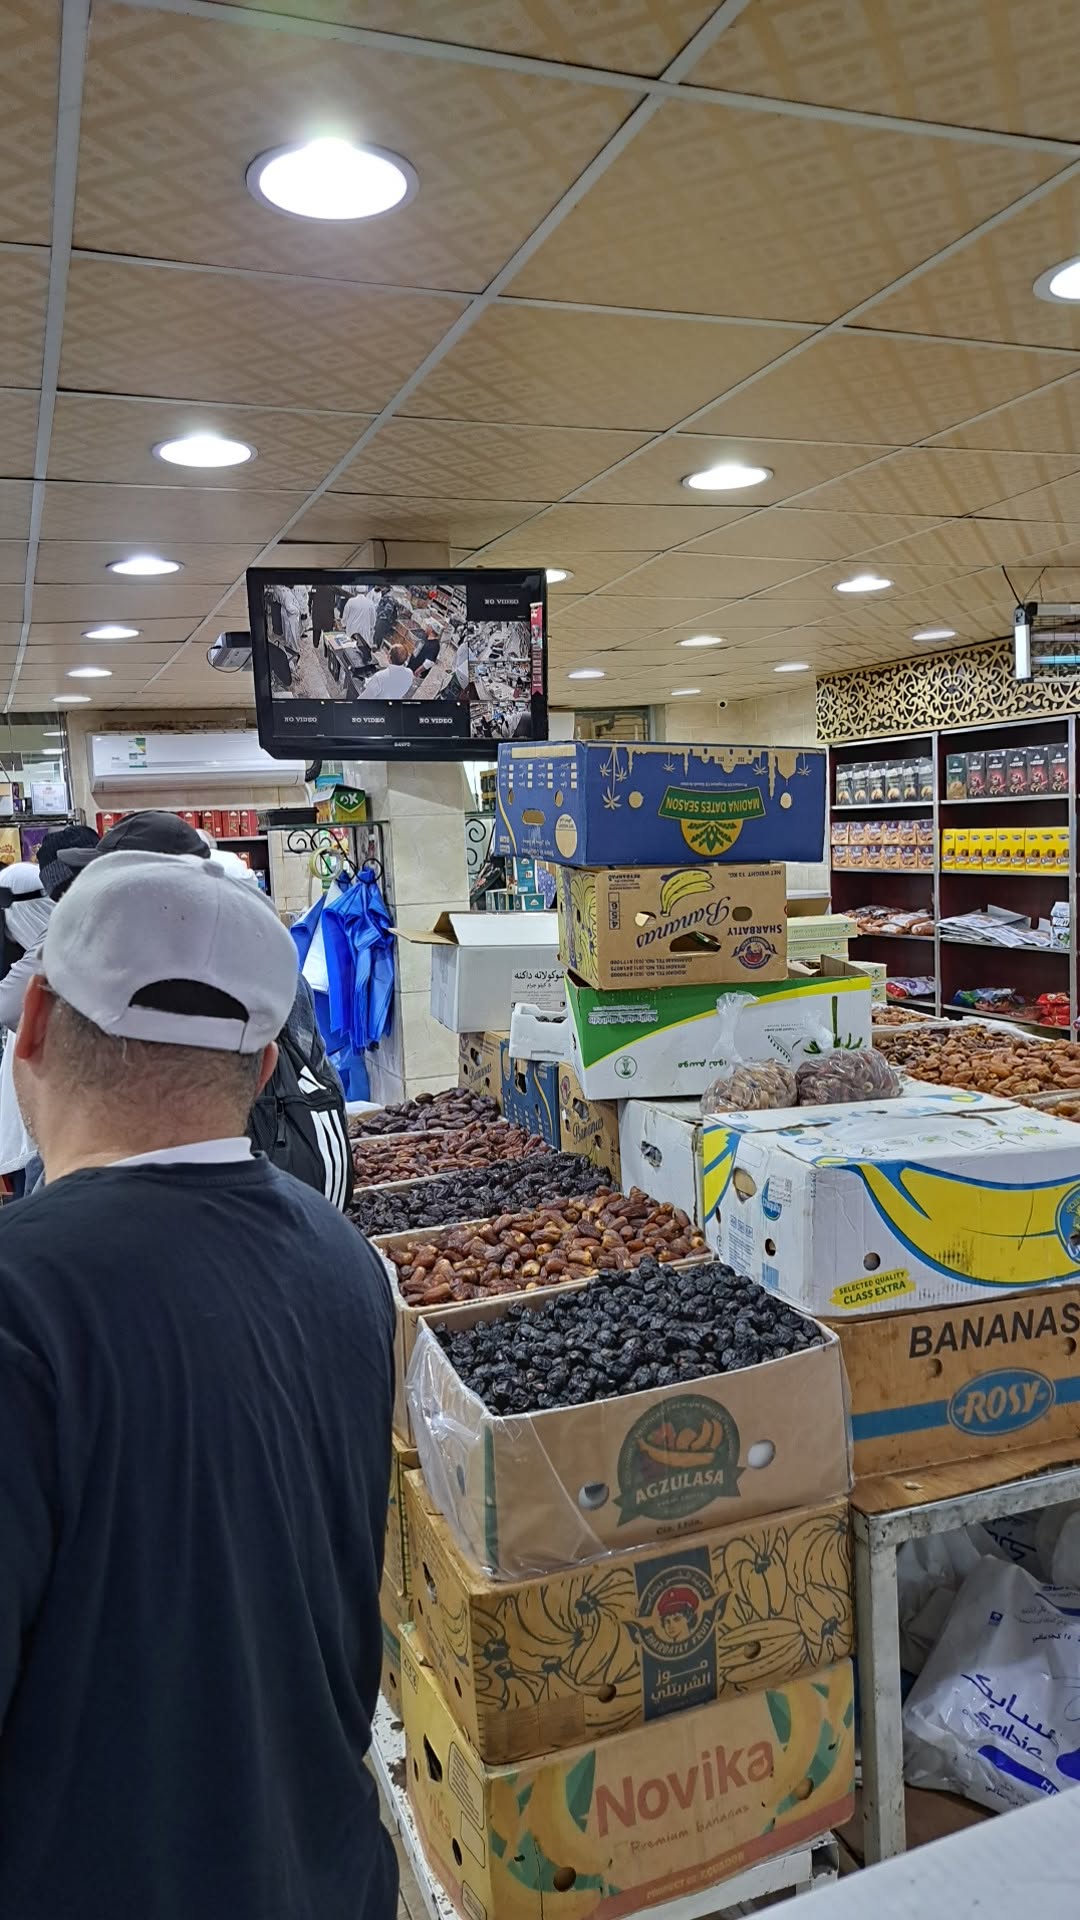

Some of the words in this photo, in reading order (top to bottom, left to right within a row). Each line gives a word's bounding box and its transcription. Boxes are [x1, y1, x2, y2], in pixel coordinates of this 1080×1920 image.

[497, 598, 520, 606] VIDEO
[352, 716, 362, 724] NO
[364, 716, 385, 724] VIDEO
[432, 717, 452, 725] VIDEO
[665, 797, 699, 812] SEASON
[729, 798, 760, 813] MADINA
[771, 869, 781, 877] NET
[636, 896, 731, 949] Bananas
[727, 924, 782, 936] SHARBATLY
[678, 1059, 706, 1070] موسم
[839, 1280, 871, 1295] SELECTED
[874, 1272, 905, 1288] QUALITY
[843, 1288, 873, 1304] CLASS
[874, 1280, 906, 1298] EXTRA
[908, 1302, 1080, 1358] BANANAS
[963, 1380, 1040, 1424] ROSY
[636, 1470, 724, 1504] AGZULASA
[651, 1672, 712, 1704] الشربتلي
[596, 1740, 774, 1838] Novika
[630, 1828, 689, 1854] Premium
[696, 1804, 750, 1833] bananas
